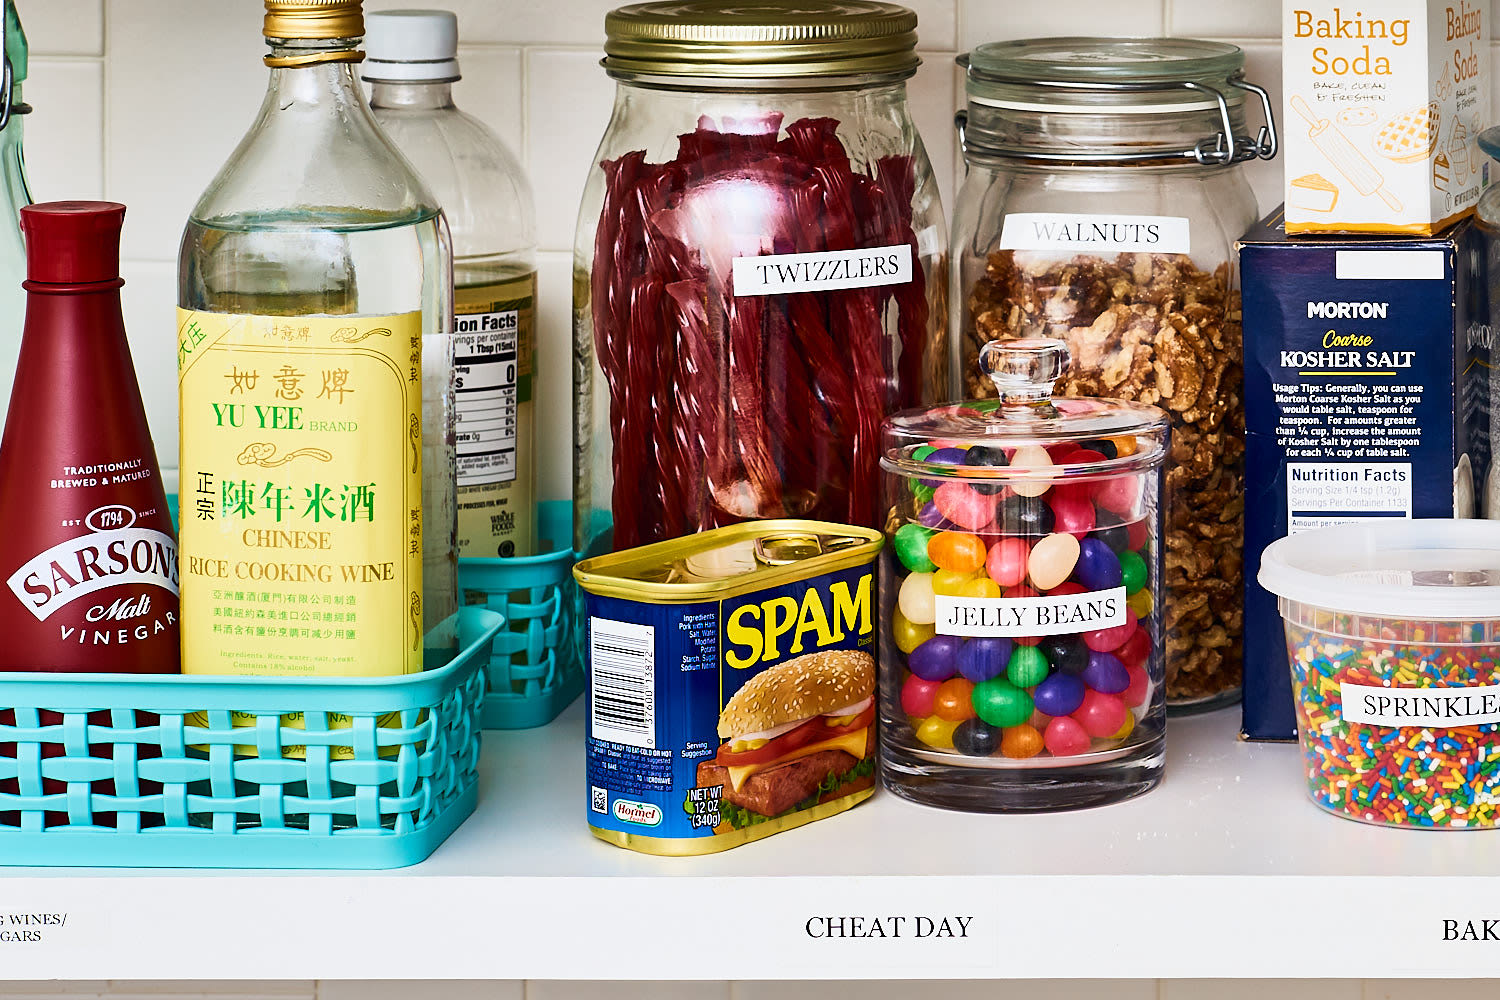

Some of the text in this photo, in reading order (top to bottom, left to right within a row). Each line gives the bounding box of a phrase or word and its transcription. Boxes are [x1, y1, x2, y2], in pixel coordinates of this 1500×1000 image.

[1293, 8, 1411, 46] Baking
[1446, 0, 1481, 41] Baking
[1311, 45, 1393, 75] Soda
[1454, 41, 1478, 84] Soda
[1032, 221, 1160, 243] WALNUTS
[756, 254, 900, 285] TWIZZLERS
[1307, 301, 1388, 319] MORTON
[481, 313, 517, 331] Facts
[1322, 329, 1374, 349] Coarse
[476, 343, 495, 355] Tbsp
[1280, 351, 1416, 368] KOSHER SALT
[506, 363, 515, 383] 0
[223, 364, 355, 404] 如意牌
[1272, 383, 1424, 395] Usage Tips: Generally, you can use
[1275, 394, 1421, 405] Morton Coarse Kosher Salt as you
[210, 402, 359, 433] YU YEE BRAND
[1282, 405, 1414, 416] would table salt, teaspoon for
[1279, 416, 1417, 427] teaspoon. For amounts greater
[1275, 427, 1422, 438] than cup, increase the amount
[1277, 437, 1287, 446] of
[1288, 437, 1319, 446] Kosher
[1320, 437, 1339, 446] Salt
[1340, 437, 1351, 447] by
[1371, 437, 1420, 447] tablespoon
[1285, 447, 1410, 458] for each cup of table salt.
[64, 458, 142, 476] TRADITIONALLY
[1292, 468, 1407, 482] Nutrition Facts
[50, 469, 151, 489] BREWED & MATURED
[195, 472, 216, 521] 正宗
[1291, 485, 1323, 495] Serving
[1325, 485, 1342, 495] Size
[1345, 485, 1358, 495] 1/4
[1360, 486, 1374, 495] tsp
[221, 479, 377, 523] 陳年米酒
[1291, 497, 1328, 508] Servings
[1329, 498, 1342, 507] Per
[1345, 498, 1384, 507] Container
[61, 508, 157, 527] EST 1794 SINCE
[1292, 519, 1319, 527] Amount
[241, 527, 332, 551] CHINESE
[188, 556, 395, 584] RICE COOKING WINE
[85, 593, 152, 623] Malt
[948, 598, 1116, 626] JELLY BEANS
[60, 611, 177, 646] VINEGAR
[725, 573, 873, 670] SPAM
[681, 748, 713, 758] Suggestion
[686, 742, 708, 751] Serving
[690, 786, 723, 801] NET WT
[618, 804, 656, 819] Hormel
[694, 800, 719, 813] 12 OZ
[692, 813, 721, 828] (340g)
[9, 913, 67, 927] WINES/
[805, 916, 974, 939] CHEAT DAY
